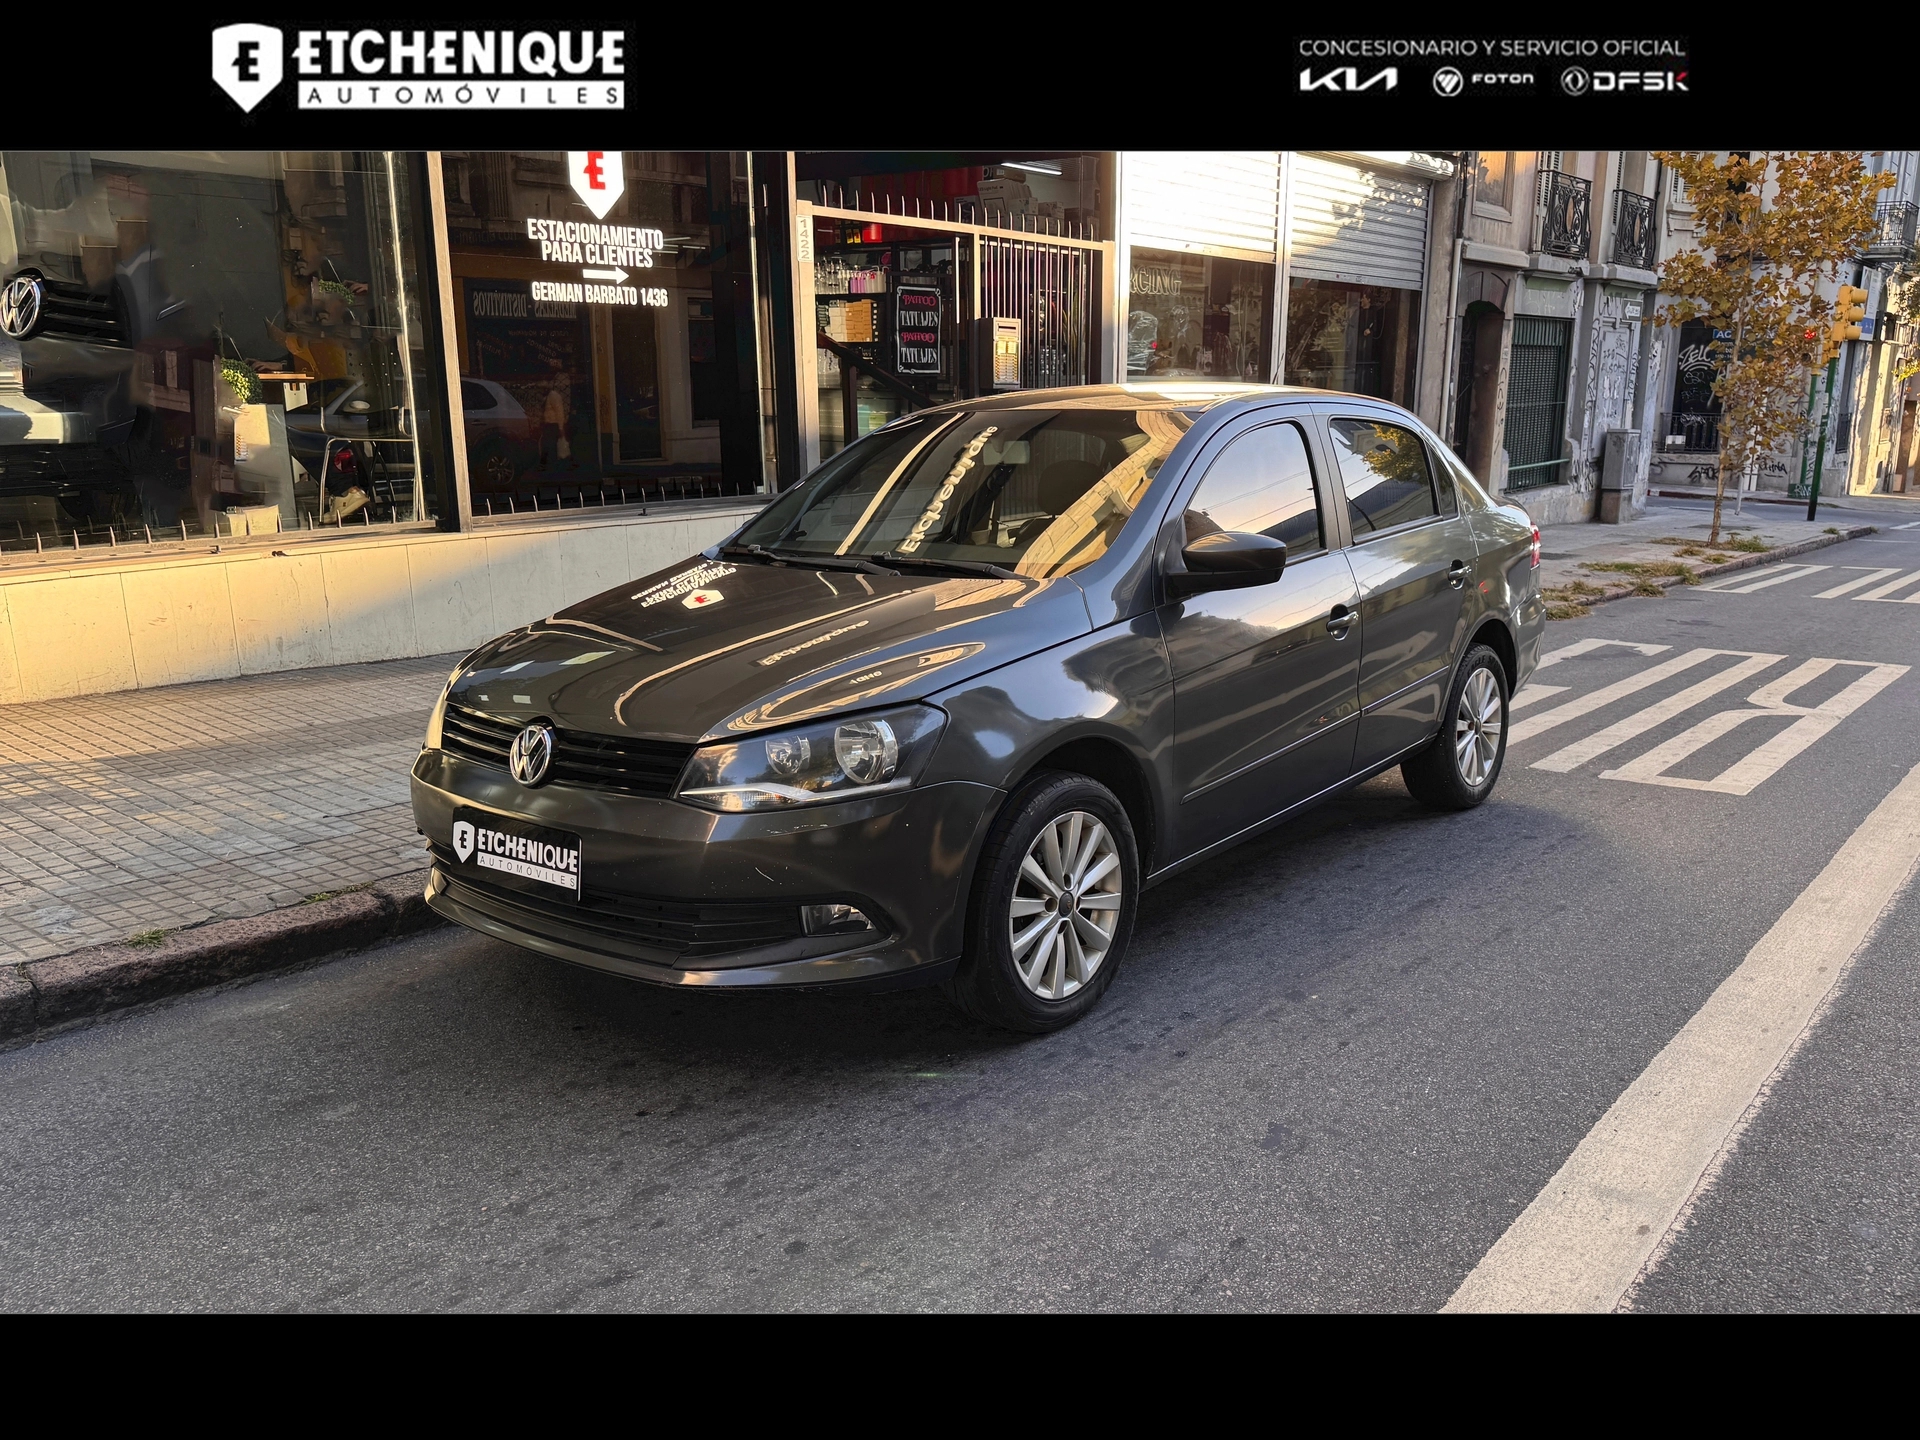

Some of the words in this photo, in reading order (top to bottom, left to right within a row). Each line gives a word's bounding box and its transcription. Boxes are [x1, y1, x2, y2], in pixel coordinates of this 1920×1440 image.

[527, 218, 664, 250] ESTACIONAMIENTO
[800, 219, 810, 260] 1422
[541, 240, 583, 263] PARA
[585, 244, 654, 268] CLIENTES
[531, 281, 583, 303] GERMAN
[585, 284, 638, 306] BARBATO
[640, 287, 669, 307] 1436
[902, 294, 937, 307] TATTOO
[900, 310, 939, 327] TATUAJES
[901, 331, 936, 343] TATTOO
[900, 347, 938, 364] TATUAJES
[477, 828, 578, 873] ETCHENIQUE
[479, 855, 576, 888] AUTOMÓVILES
